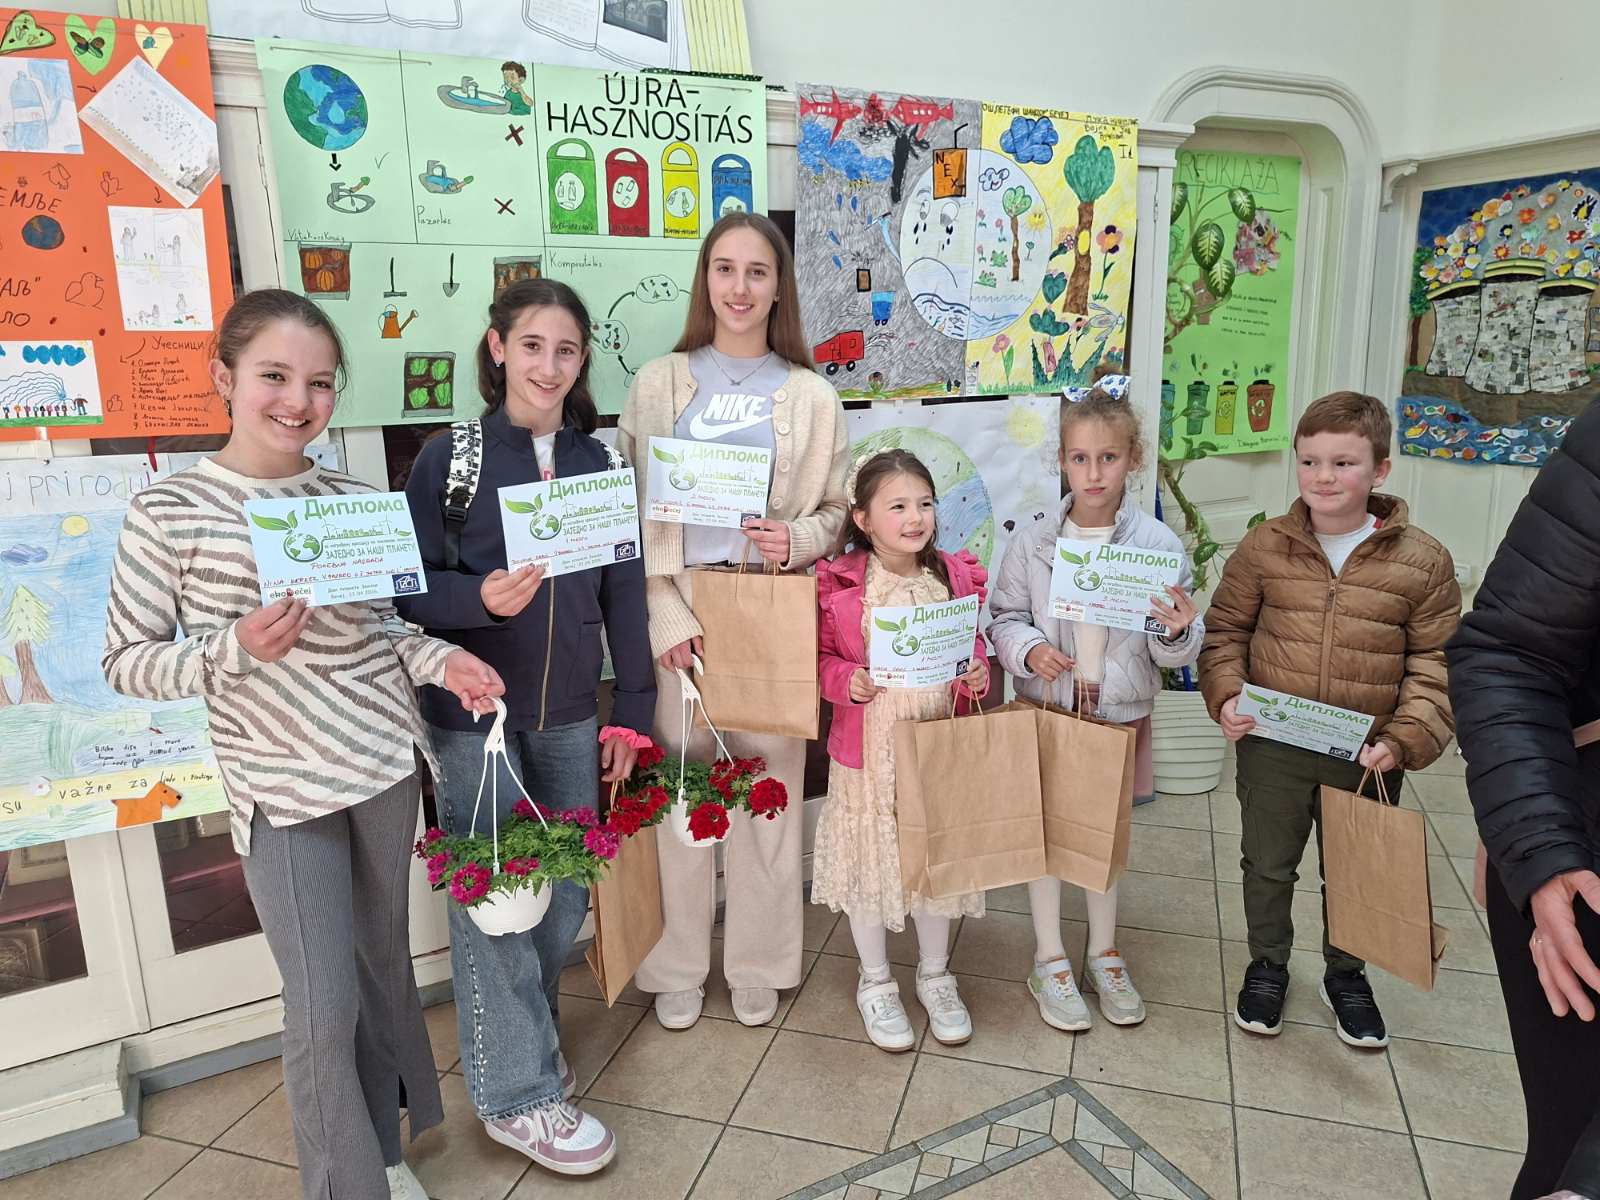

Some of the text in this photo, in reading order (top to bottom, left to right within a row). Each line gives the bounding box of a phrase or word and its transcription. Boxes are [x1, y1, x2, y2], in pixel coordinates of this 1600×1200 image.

[605, 72, 700, 108] ÚJRA-
[546, 102, 753, 144] HASZNOSÍTÁS
[152, 335, 206, 350] Учесници
[703, 393, 767, 420] NIKE
[689, 443, 769, 465] Диплома
[548, 474, 633, 502] Диплома
[304, 499, 405, 521] Диплома
[326, 550, 355, 560] ЗАЈЕДНО
[358, 549, 366, 557] ЗА
[367, 546, 385, 555] НАШУ
[1096, 545, 1178, 569] Диплома
[912, 601, 977, 625] Диплома
[1284, 696, 1370, 727] Диплома
[129, 778, 148, 789] za
